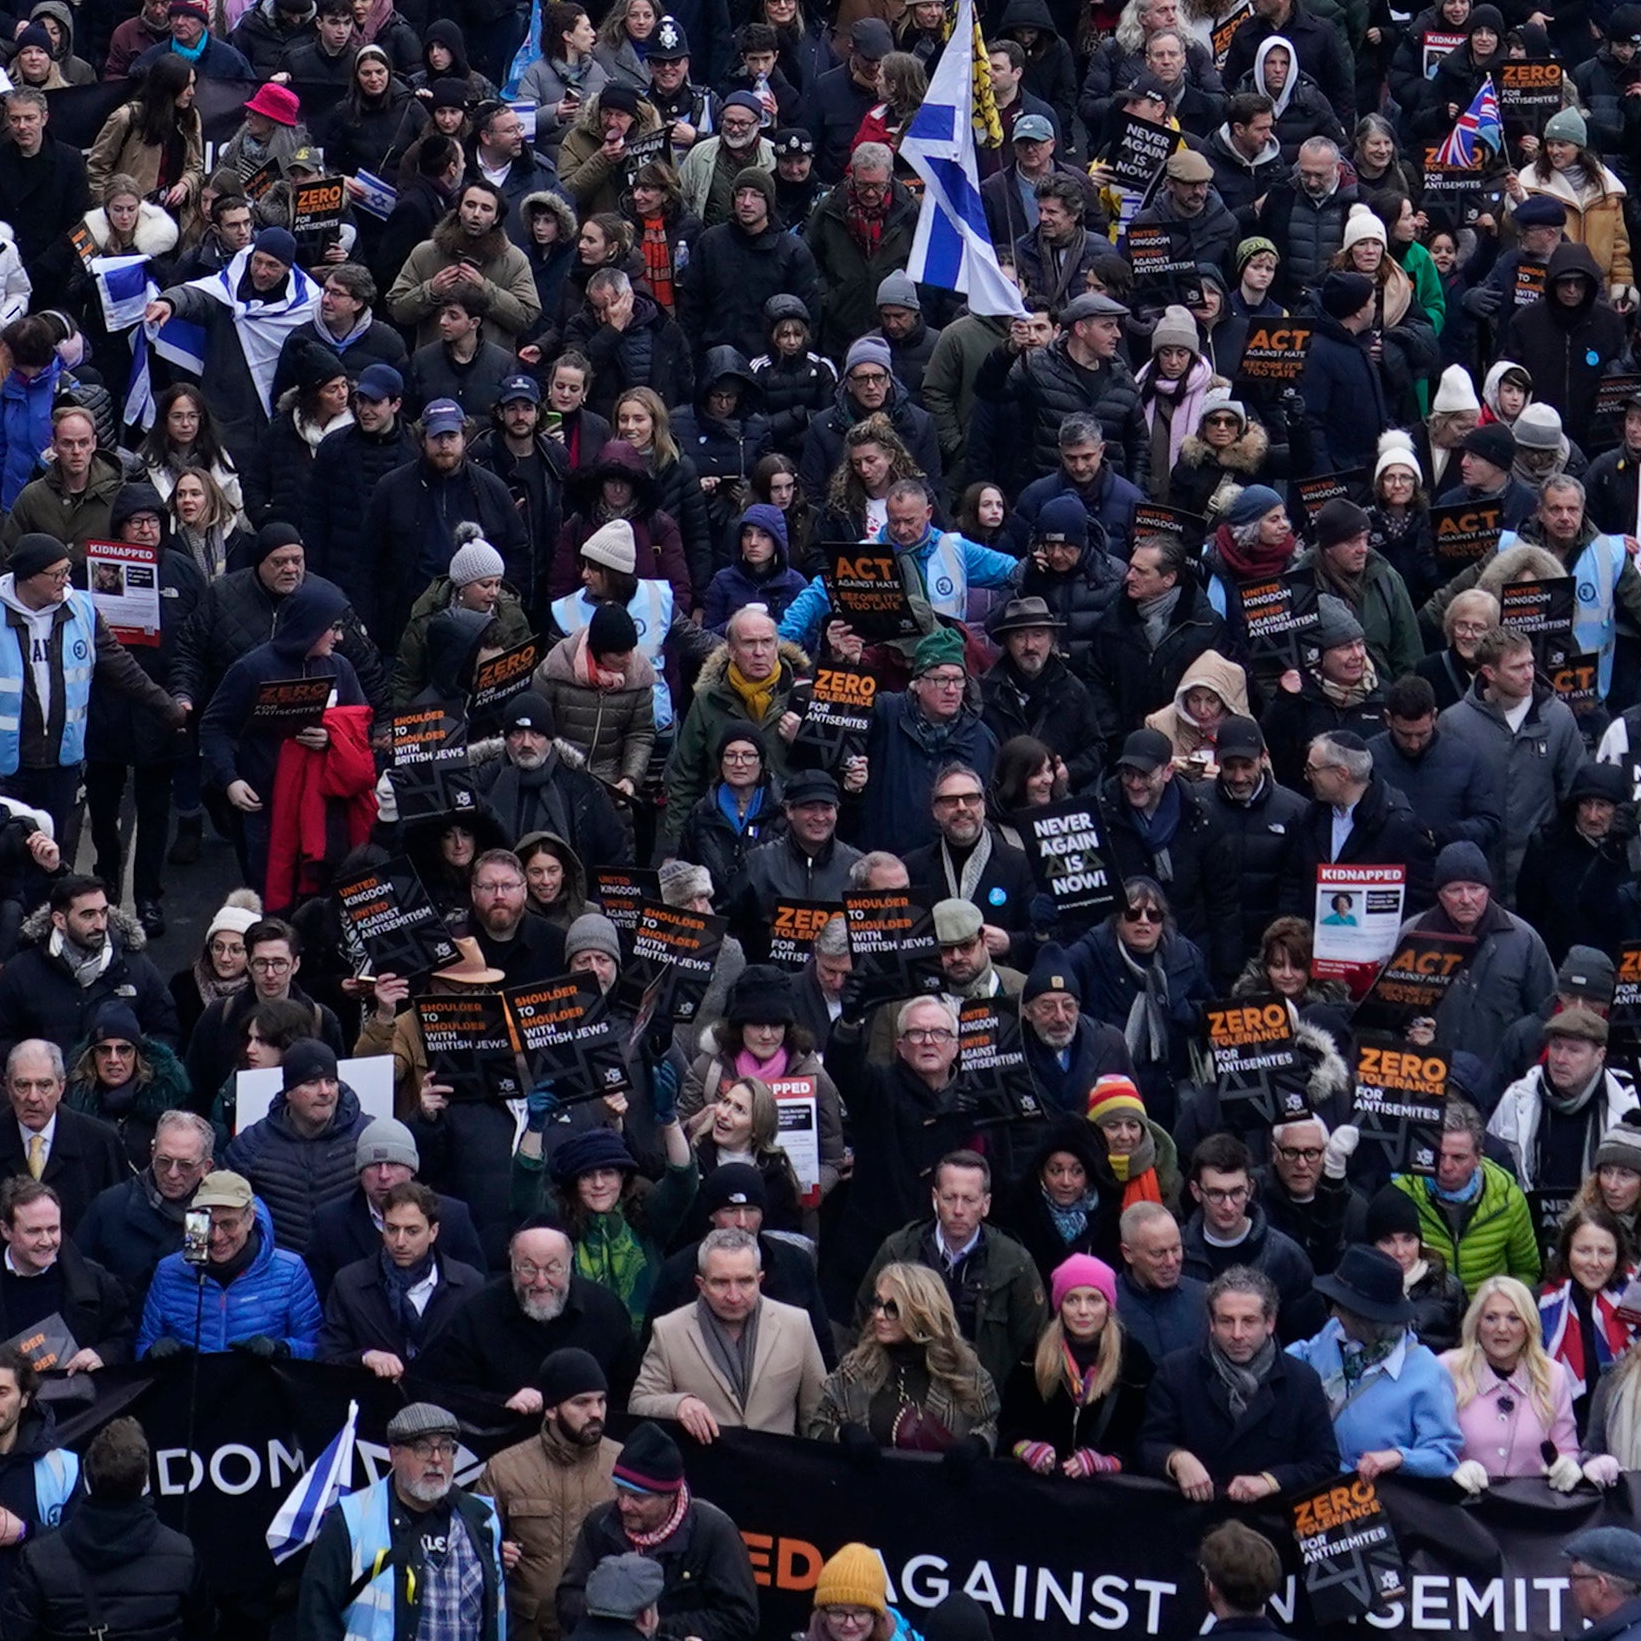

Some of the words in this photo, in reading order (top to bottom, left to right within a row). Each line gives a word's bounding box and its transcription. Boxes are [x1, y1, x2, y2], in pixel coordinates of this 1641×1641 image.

[1502, 65, 1562, 81] ZERO
[1502, 90, 1521, 98] FOR
[298, 185, 342, 207] ZERO
[1249, 328, 1310, 351] ACT
[90, 544, 154, 562] KIDNAPPED
[837, 558, 893, 581] ACT
[1243, 589, 1293, 609] KINGDOM
[1248, 611, 1292, 631] AGAINST
[814, 669, 876, 694] ZERO
[805, 711, 868, 731] ANTISEMITES
[1033, 813, 1095, 839] NEVER
[1039, 831, 1100, 858] AGAIN
[1064, 856, 1083, 874] IS
[1052, 870, 1108, 896] NOW!
[1321, 869, 1403, 882] KIDNAPPED
[343, 883, 395, 908] KINGDOM
[356, 907, 401, 930] AGAINST
[361, 906, 434, 940] ANTISEMITISM
[642, 918, 659, 930] TO
[848, 910, 865, 921] TO
[636, 937, 668, 952] WITH
[850, 931, 883, 942] WITH
[853, 940, 898, 953] BRITISH
[901, 937, 935, 949] JEWS
[678, 958, 711, 973] JEWS
[422, 1013, 438, 1023] TO
[518, 1006, 536, 1018] TO
[1208, 1005, 1287, 1037] ZERO
[425, 1032, 457, 1042] WITH
[523, 1025, 557, 1039] WITH
[528, 1031, 575, 1050] BRITISH
[576, 1023, 610, 1039] JEWS
[427, 1041, 474, 1051] BRITISH
[476, 1040, 509, 1050] JEWS
[1215, 1050, 1239, 1064] FOR
[1217, 1053, 1294, 1074] ANTISEMITES
[1358, 1048, 1448, 1083] ZERO
[1356, 1086, 1384, 1101] FOR
[1356, 1099, 1440, 1121] ANTISEMITES
[1293, 1479, 1376, 1522] ZERO
[1303, 1527, 1388, 1566] ANTISEMITES
